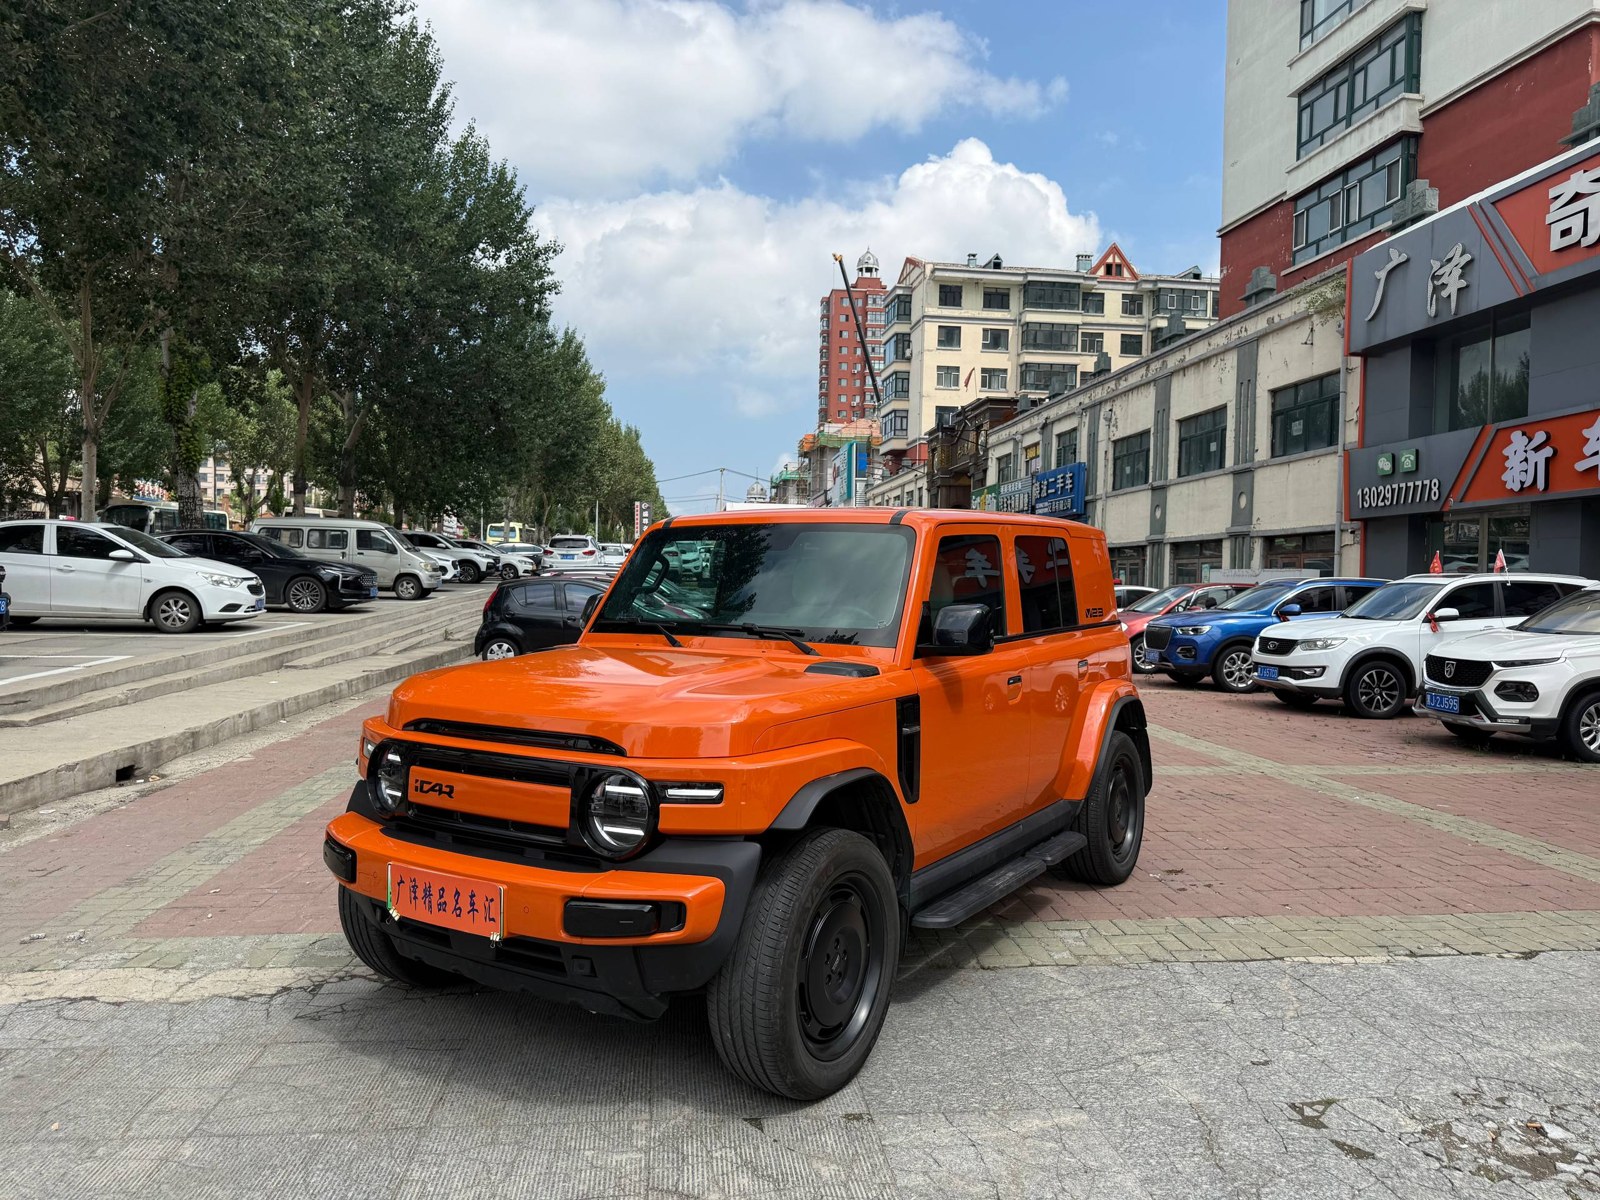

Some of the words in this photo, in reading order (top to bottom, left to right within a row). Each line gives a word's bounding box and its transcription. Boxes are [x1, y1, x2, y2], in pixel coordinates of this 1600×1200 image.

[1545, 167, 1600, 252] 奇
[1365, 242, 1473, 322] 广泽
[1357, 478, 1440, 509] 13029777778
[414, 778, 455, 799] iCAR
[394, 873, 497, 924] 广泽精品名车汇
